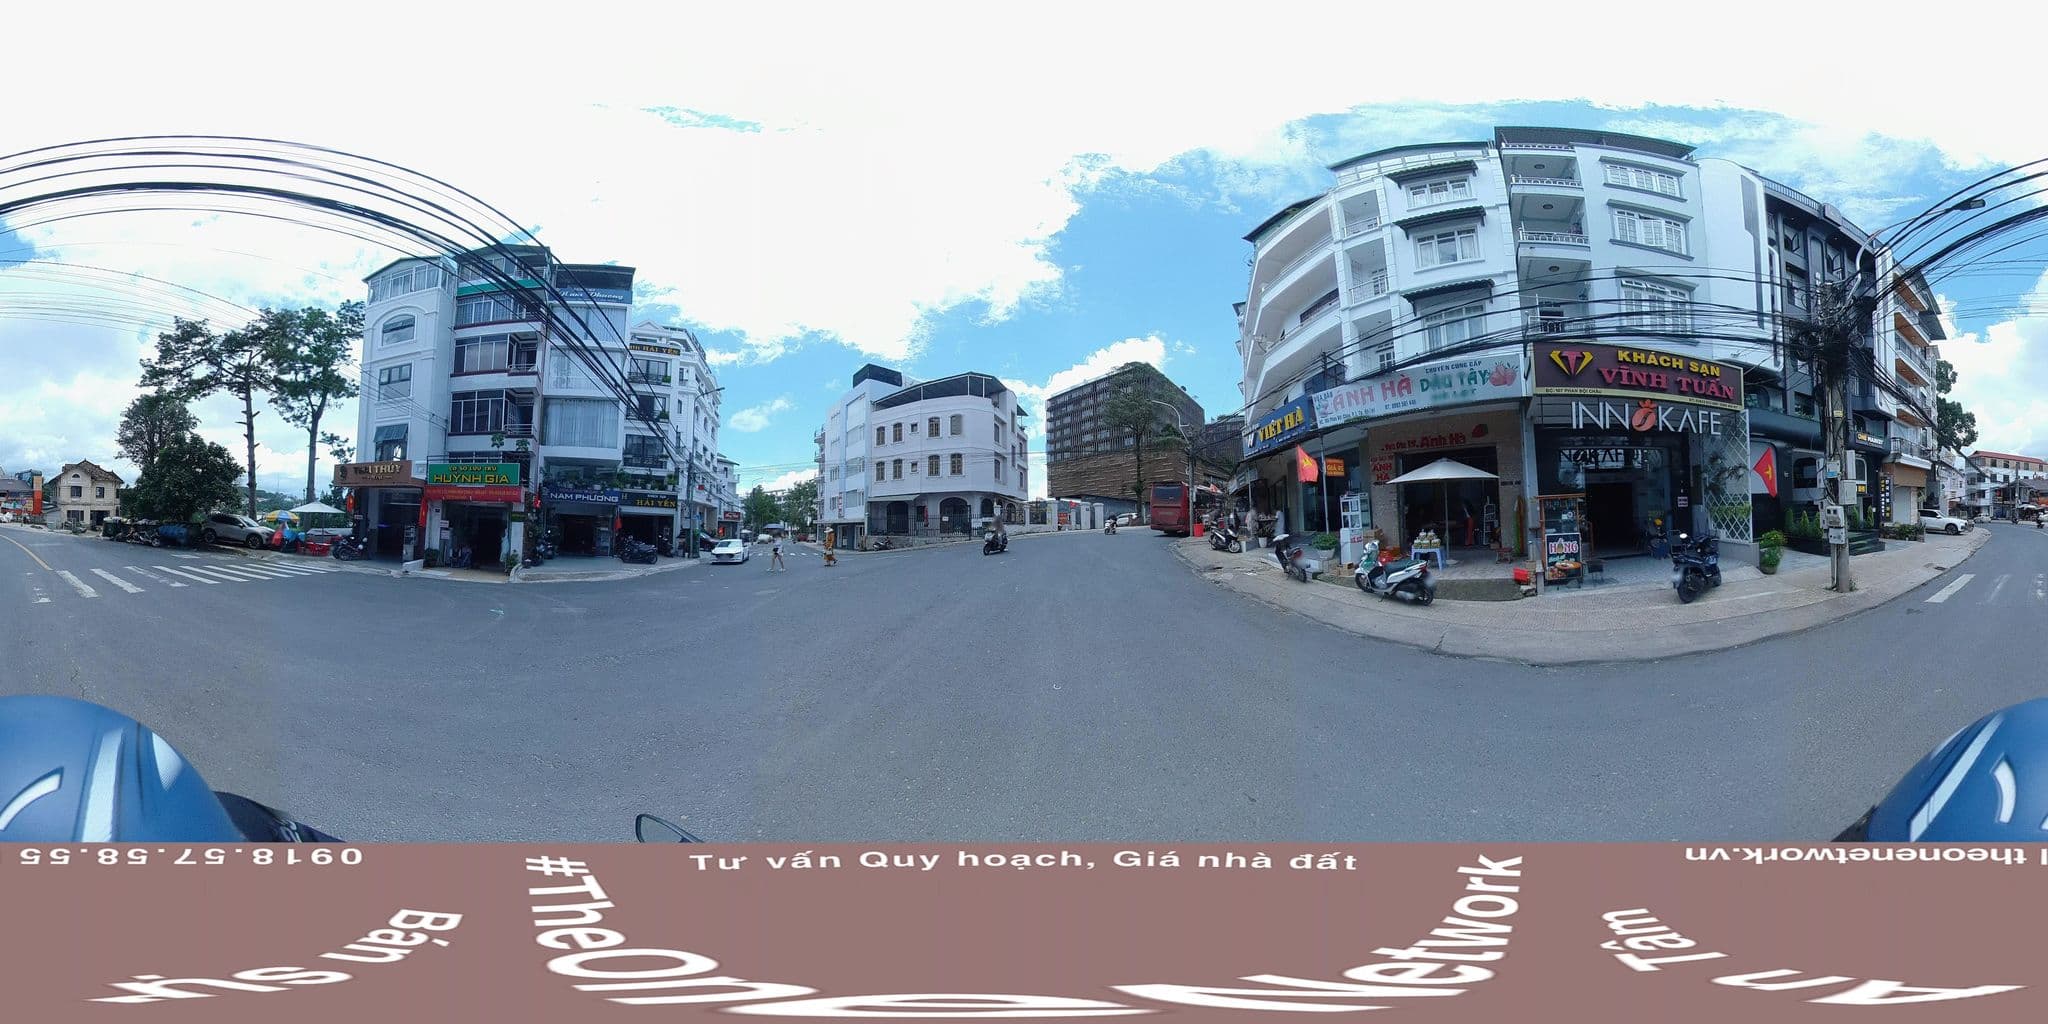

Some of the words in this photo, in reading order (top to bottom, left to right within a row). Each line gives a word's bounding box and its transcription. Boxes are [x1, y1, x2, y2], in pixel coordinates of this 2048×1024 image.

[1617, 350, 1684, 369] KHÁCH
[1689, 361, 1721, 377] SẠN
[1380, 374, 1412, 402] HÀ
[1600, 364, 1669, 389] VĨNH
[1676, 375, 1735, 400] TUẤN
[434, 472, 481, 483] HUỲNH
[485, 474, 509, 483] GIA
[550, 492, 573, 500] NAM
